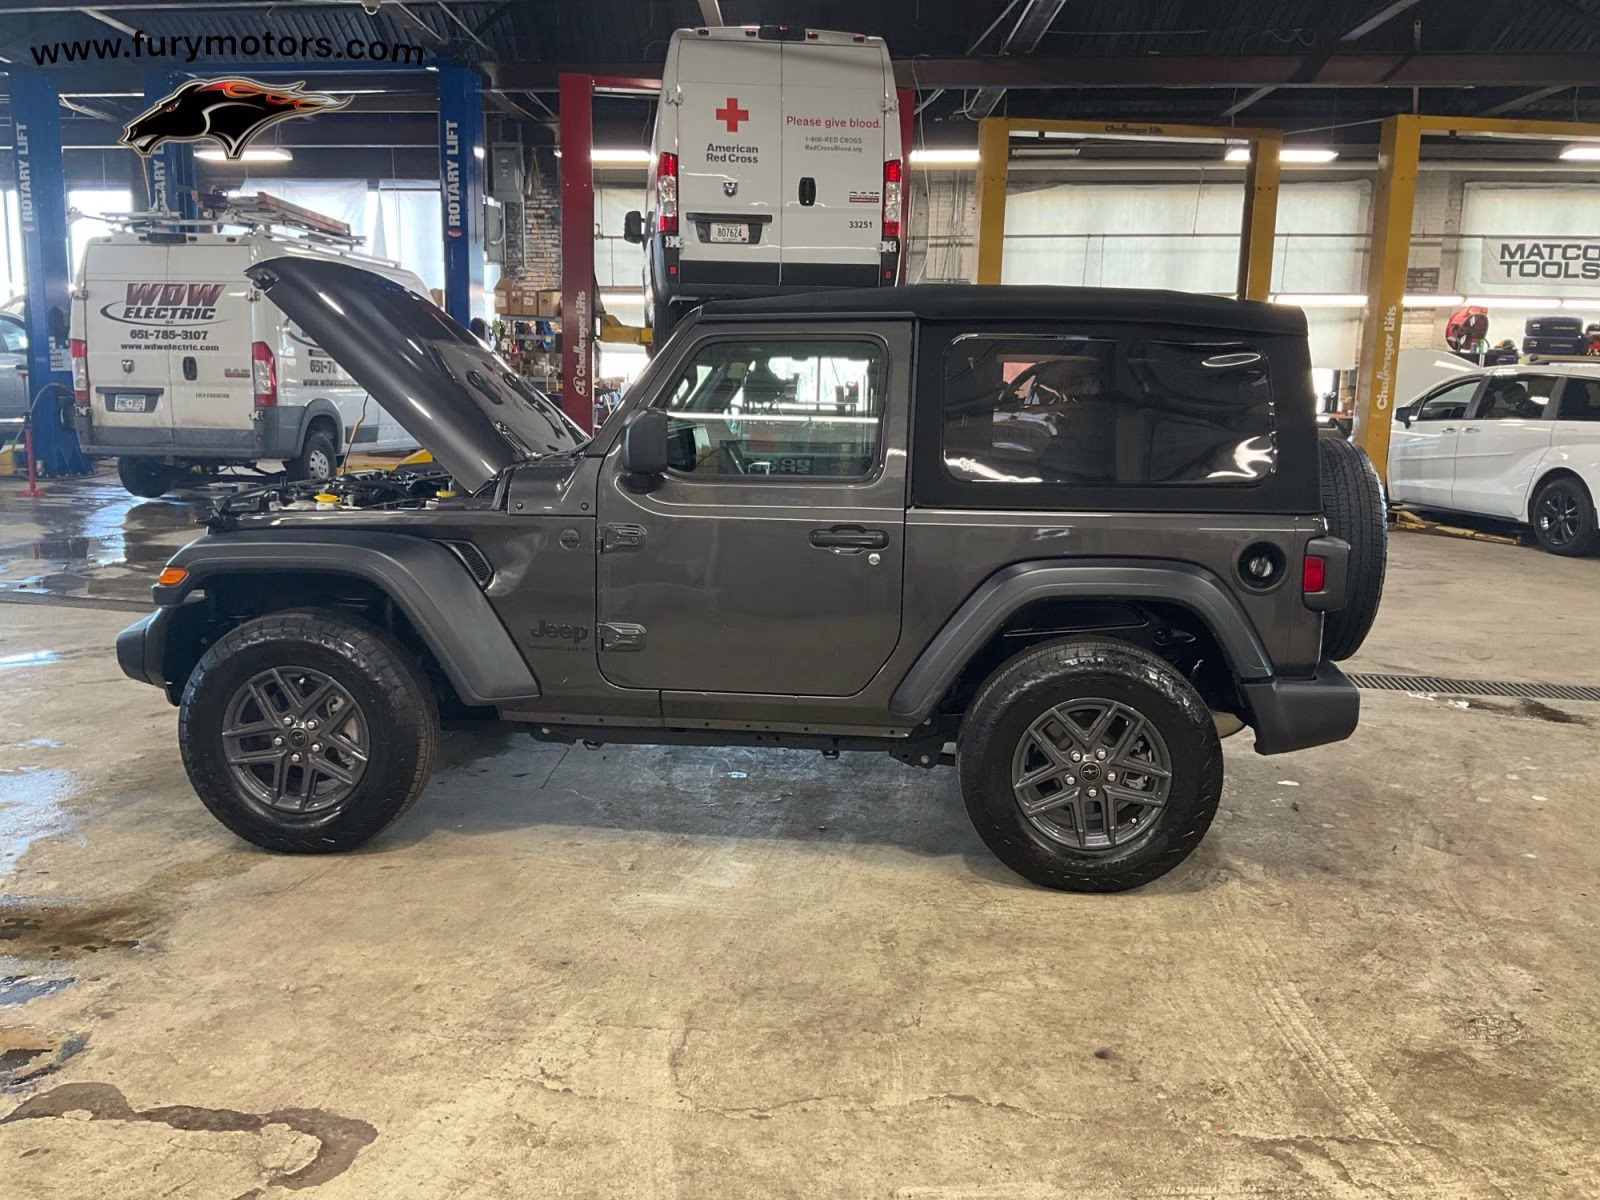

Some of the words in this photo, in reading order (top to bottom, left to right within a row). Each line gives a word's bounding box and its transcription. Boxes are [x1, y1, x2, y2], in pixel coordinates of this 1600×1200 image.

[786, 115, 821, 127] Please
[825, 117, 847, 129] give
[849, 118, 881, 129] blood.
[16, 122, 28, 155] LIFT
[446, 120, 459, 155] LIFT
[706, 143, 759, 154] American
[706, 153, 727, 162] Red
[728, 154, 759, 163] Cross
[18, 160, 33, 222] ROTARY
[447, 160, 460, 227] ROTARY
[717, 227, 742, 238] 807624
[849, 221, 873, 229] 33251
[1500, 243, 1600, 261] MATCO
[1500, 260, 1600, 279] TOOLS
[125, 283, 226, 307] WDW
[576, 291, 586, 315] Lifts
[123, 306, 216, 320] ELECTRIC
[1384, 304, 1396, 332] Lifts
[130, 329, 208, 341] 651-785-3107
[573, 315, 588, 376] Challenger
[120, 343, 219, 352] www.wdwelectric.com
[1376, 333, 1395, 410] Challenger
[530, 619, 588, 644] Jeep
